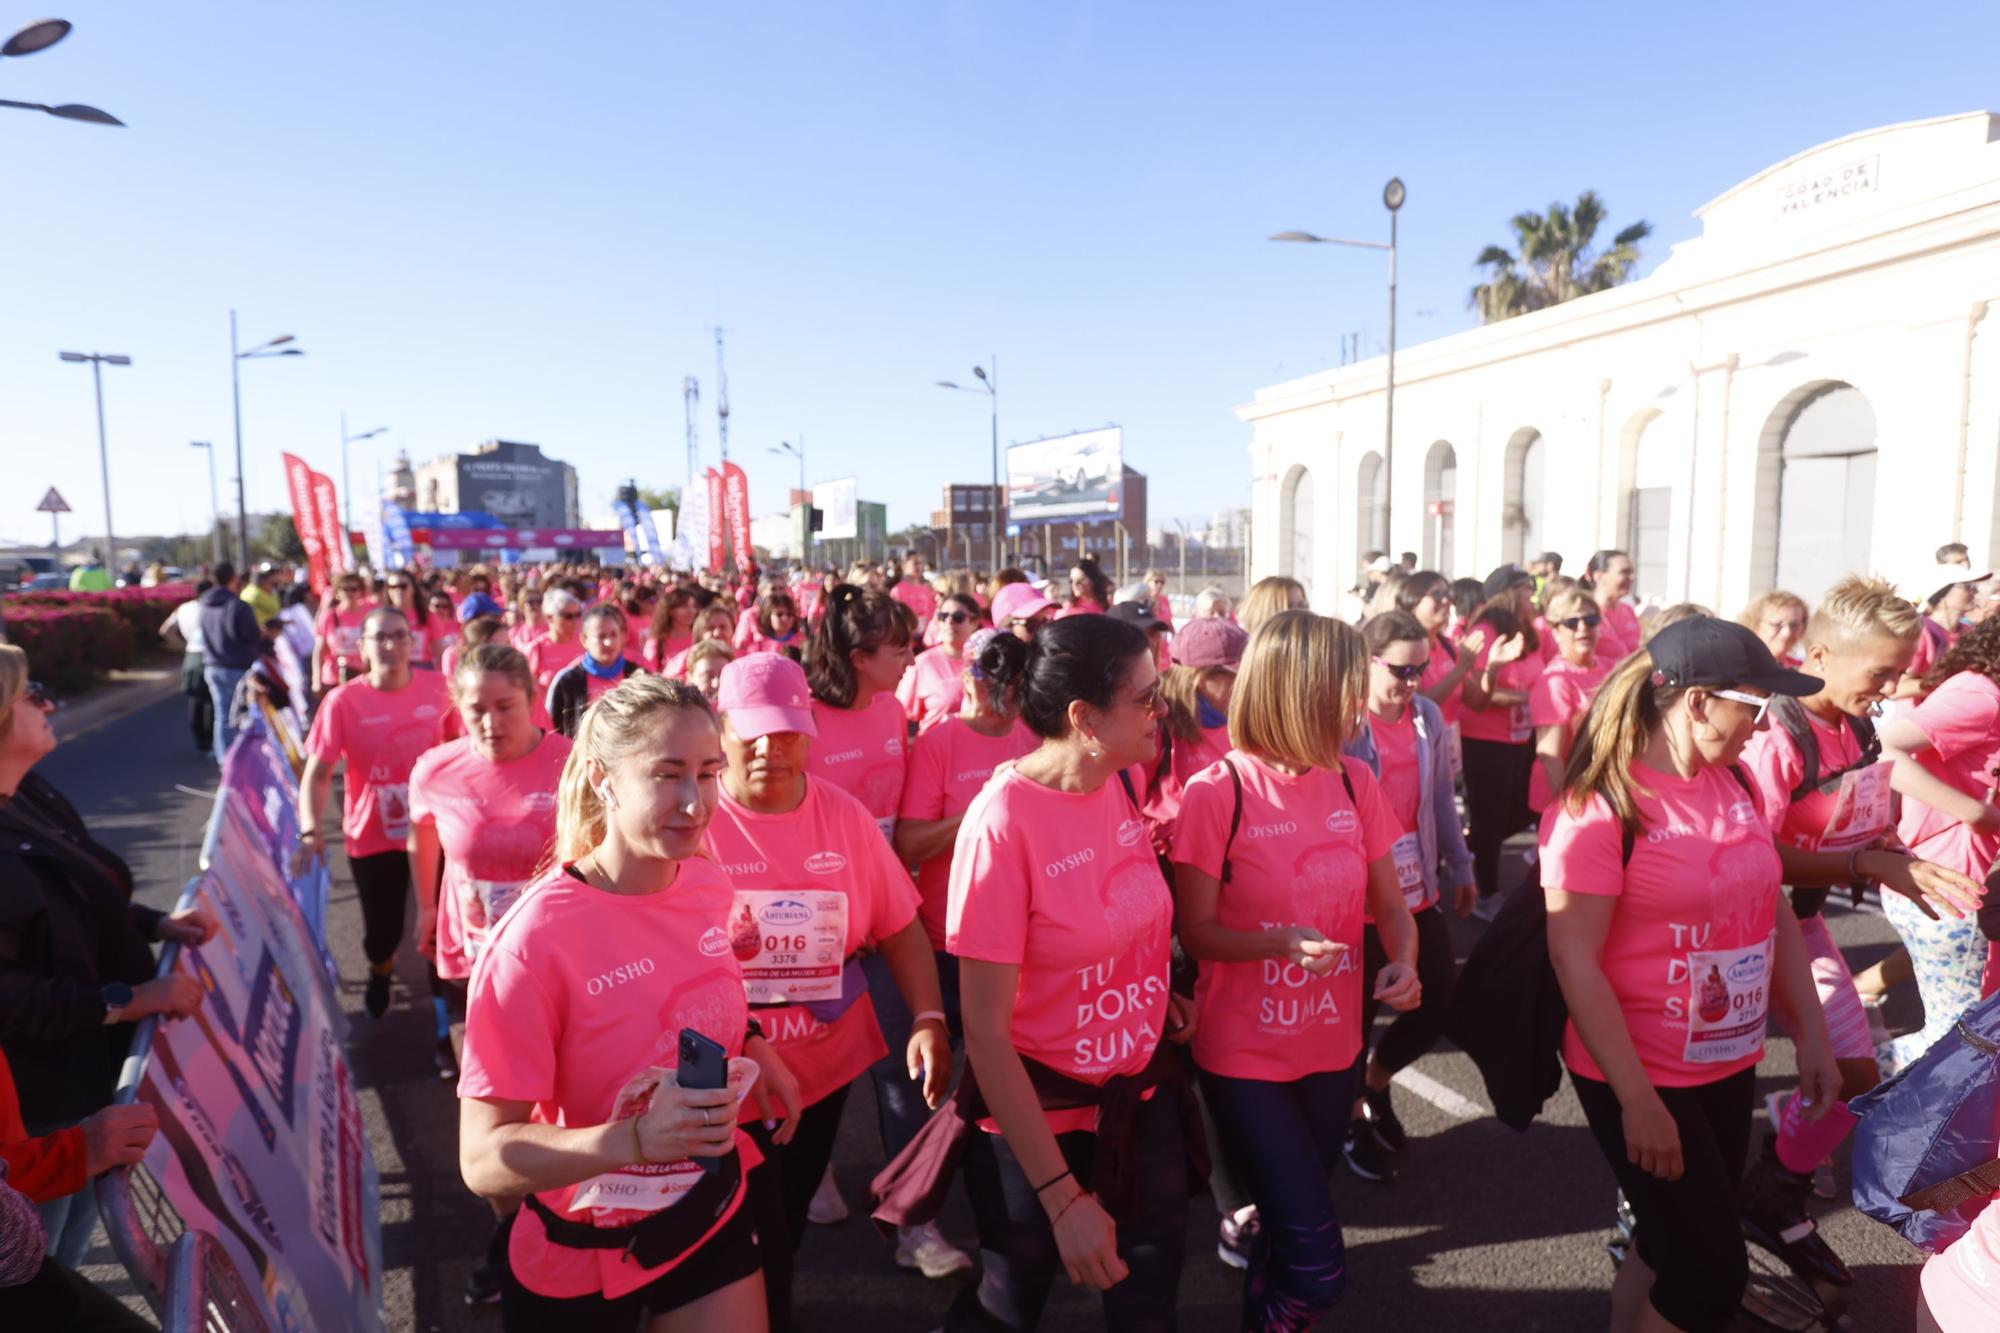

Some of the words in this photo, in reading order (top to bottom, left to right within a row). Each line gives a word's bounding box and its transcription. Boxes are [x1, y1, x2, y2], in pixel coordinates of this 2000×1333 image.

[1843, 164, 1867, 181] DE
[1782, 178, 1869, 212] VALENCIA
[824, 749, 863, 765] OYSHO
[1854, 803, 1873, 821] 016
[1247, 821, 1298, 839] OYSHO
[724, 861, 768, 876] YSHO
[1045, 847, 1096, 878] OYSHO
[764, 935, 806, 951] 016
[1668, 922, 1711, 949] TU
[586, 958, 655, 995] OYSHO
[1076, 957, 1115, 991] TU
[1260, 988, 1338, 1026] SUMA
[1733, 986, 1762, 1010] 016
[1074, 1021, 1157, 1066] SUMA
[1699, 1044, 1737, 1056] OYSHO
